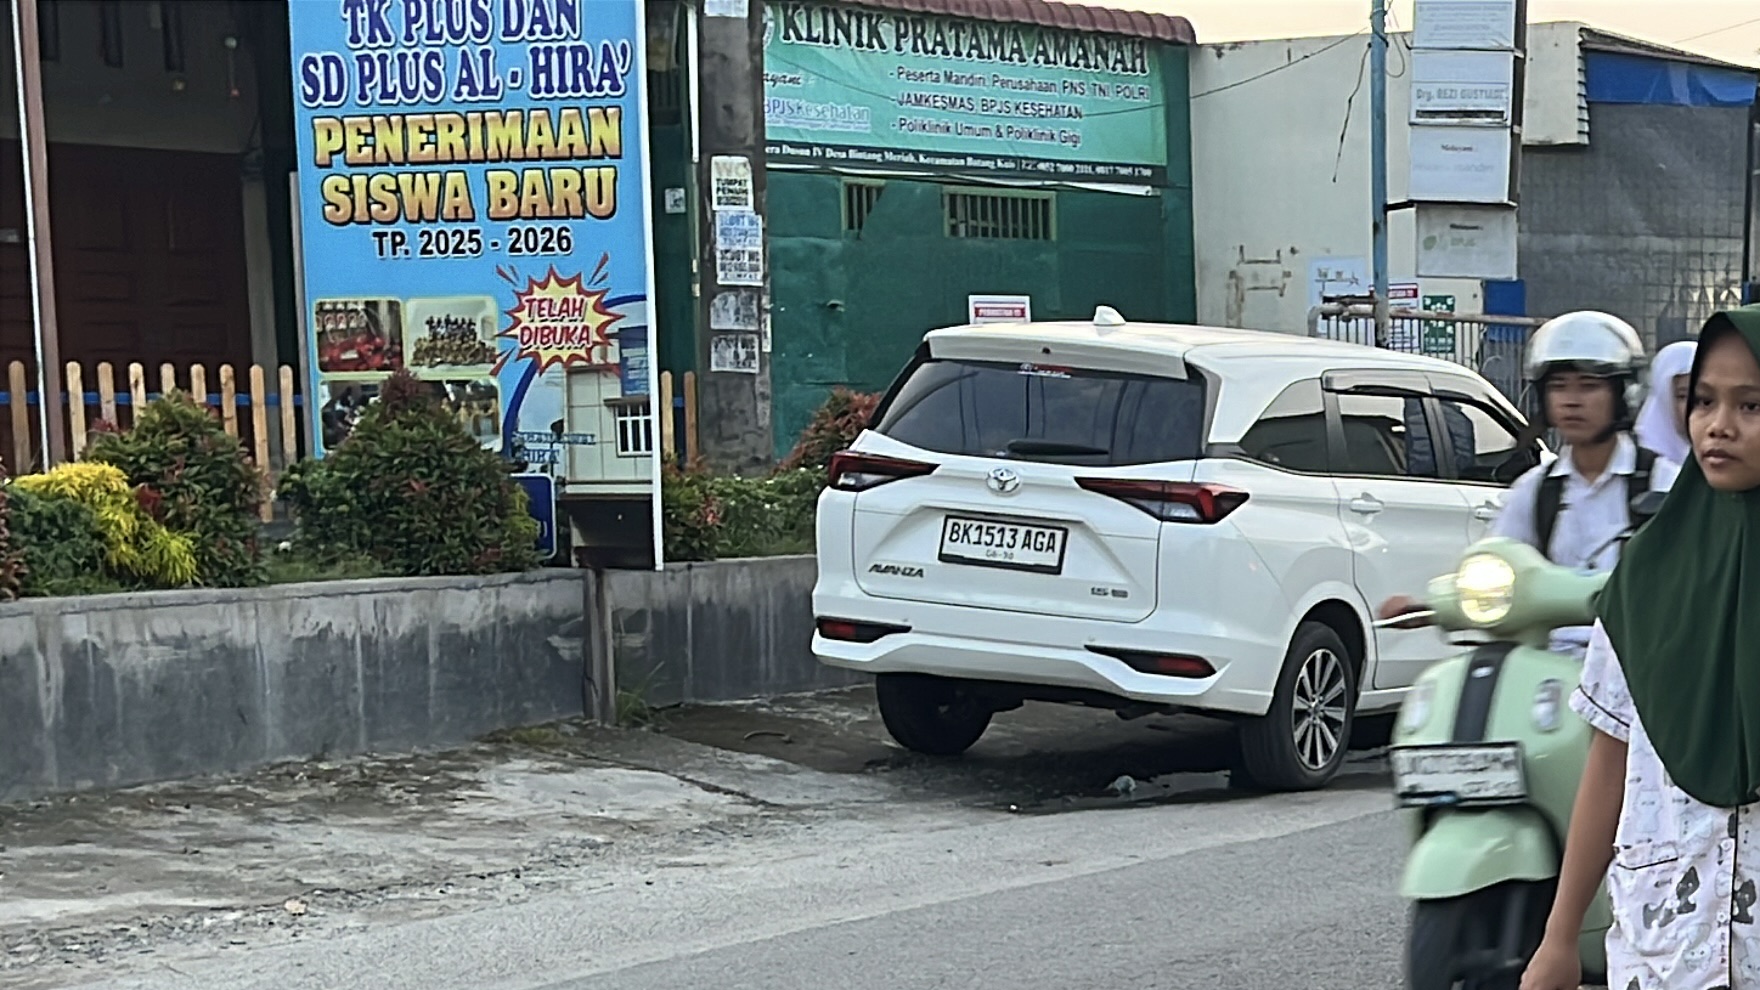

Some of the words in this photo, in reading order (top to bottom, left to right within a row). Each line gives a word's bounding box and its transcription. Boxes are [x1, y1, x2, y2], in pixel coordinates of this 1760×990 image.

[343, 0, 393, 45] TK
[403, 0, 492, 43] PLUS
[502, 0, 580, 41] DAN
[782, 4, 887, 51] KLINIK
[894, 15, 1027, 64] PRATAMA
[1033, 28, 1149, 75] AMANAH
[301, 54, 347, 104] SD
[355, 51, 443, 102] PLUS
[454, 47, 501, 98] AL
[897, 67, 940, 83] Peserta
[981, 98, 1011, 114] BPJS
[1014, 101, 1082, 119] KESEHATAN
[313, 107, 623, 167] PENERIMAAN
[899, 118, 951, 134] Poliklinik
[956, 123, 992, 138] Umum
[995, 125, 1003, 138] &
[1007, 125, 1056, 142] Poliklinik
[322, 171, 476, 225] SISWA
[486, 166, 617, 220] BARU
[373, 231, 409, 257] TP.
[418, 229, 481, 256] 2025
[508, 226, 573, 253] 2026
[523, 298, 585, 322] TELAH
[518, 325, 594, 348] DIBUKA
[949, 521, 1018, 549] BK1513
[1021, 529, 1056, 553] AGA
[868, 563, 924, 578] AVANZA
